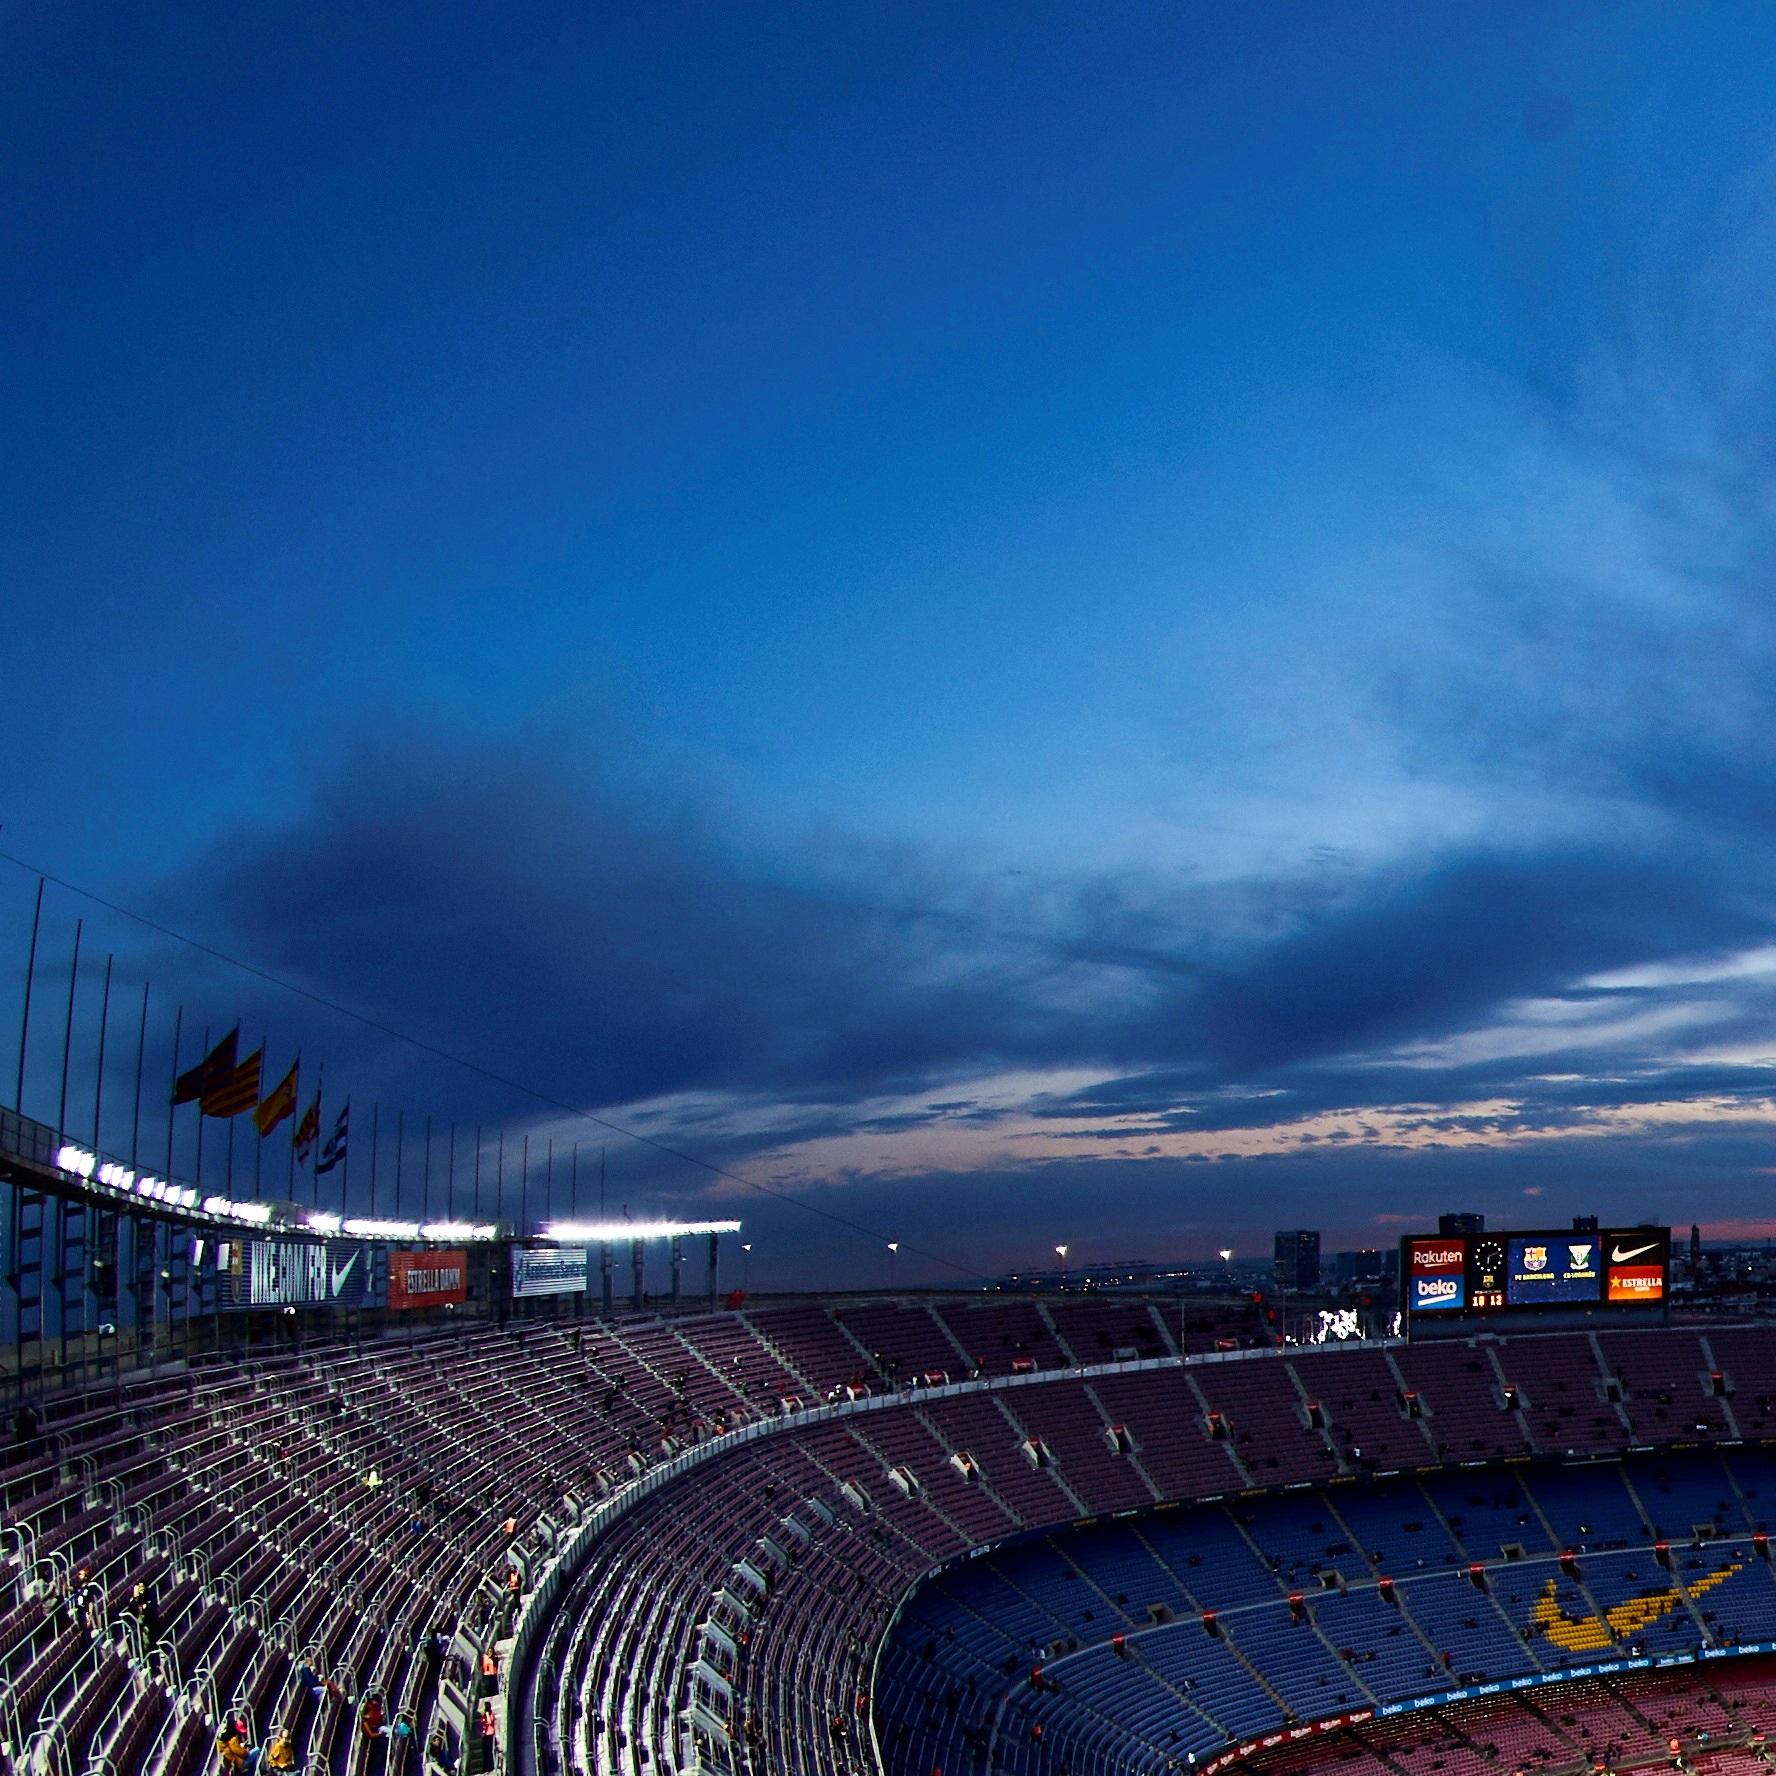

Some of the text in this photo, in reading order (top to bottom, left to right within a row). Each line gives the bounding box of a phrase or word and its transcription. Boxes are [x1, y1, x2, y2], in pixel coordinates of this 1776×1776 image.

[1413, 1249, 1463, 1265] Rakuten
[251, 1240, 327, 1304] NIKE.COM/FCB
[1418, 1279, 1457, 1296] beko
[1622, 1277, 1663, 1288] ESTRELLA
[1705, 1649, 1726, 1658] beko
[1739, 1645, 1759, 1654] beko
[1383, 1659, 1648, 1715] beko beko beko beko beko beko beko beko beko
